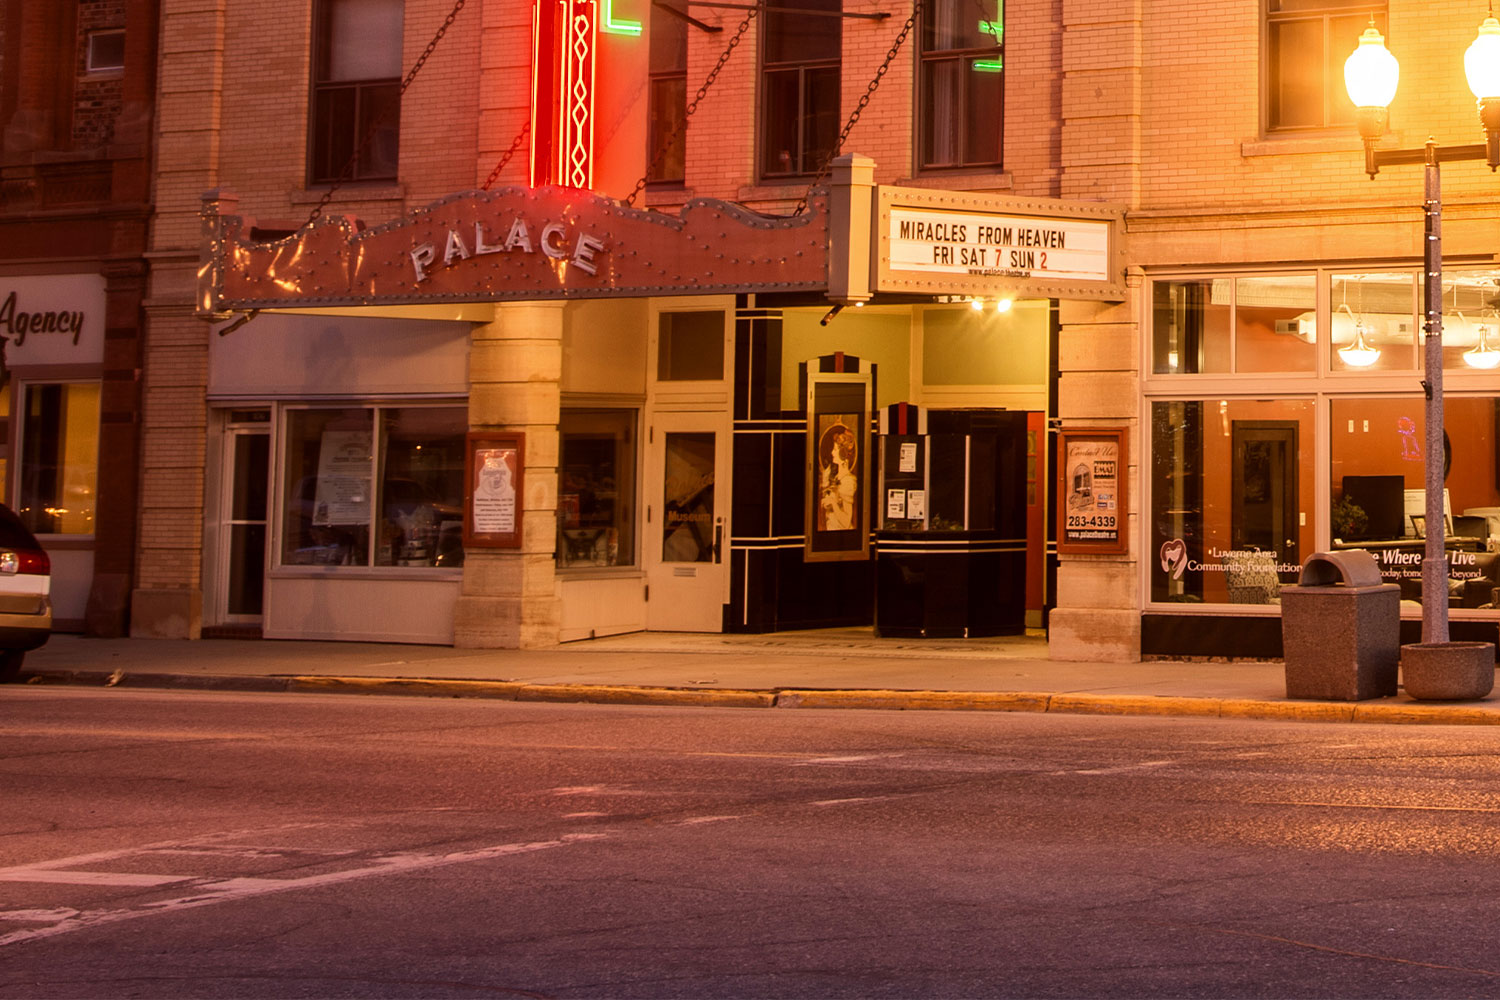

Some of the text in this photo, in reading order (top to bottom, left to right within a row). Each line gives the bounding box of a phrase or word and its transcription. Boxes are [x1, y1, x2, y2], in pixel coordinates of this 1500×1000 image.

[900, 220, 1066, 249] MIRACLES FROM HEAVEN
[410, 217, 604, 282] PALACE
[933, 246, 1047, 269] FRI SAT 7 SUN 2
[0, 291, 84, 347] Agency
[1069, 446, 1101, 457] Contact
[668, 511, 711, 521] Museum
[1068, 516, 1116, 527] 283-4339
[1213, 547, 1278, 558] Luverne Area
[1383, 548, 1422, 565] Where
[1451, 550, 1477, 566] Live
[1187, 560, 1303, 575] Community Foundation
[1452, 568, 1482, 581] beyond
